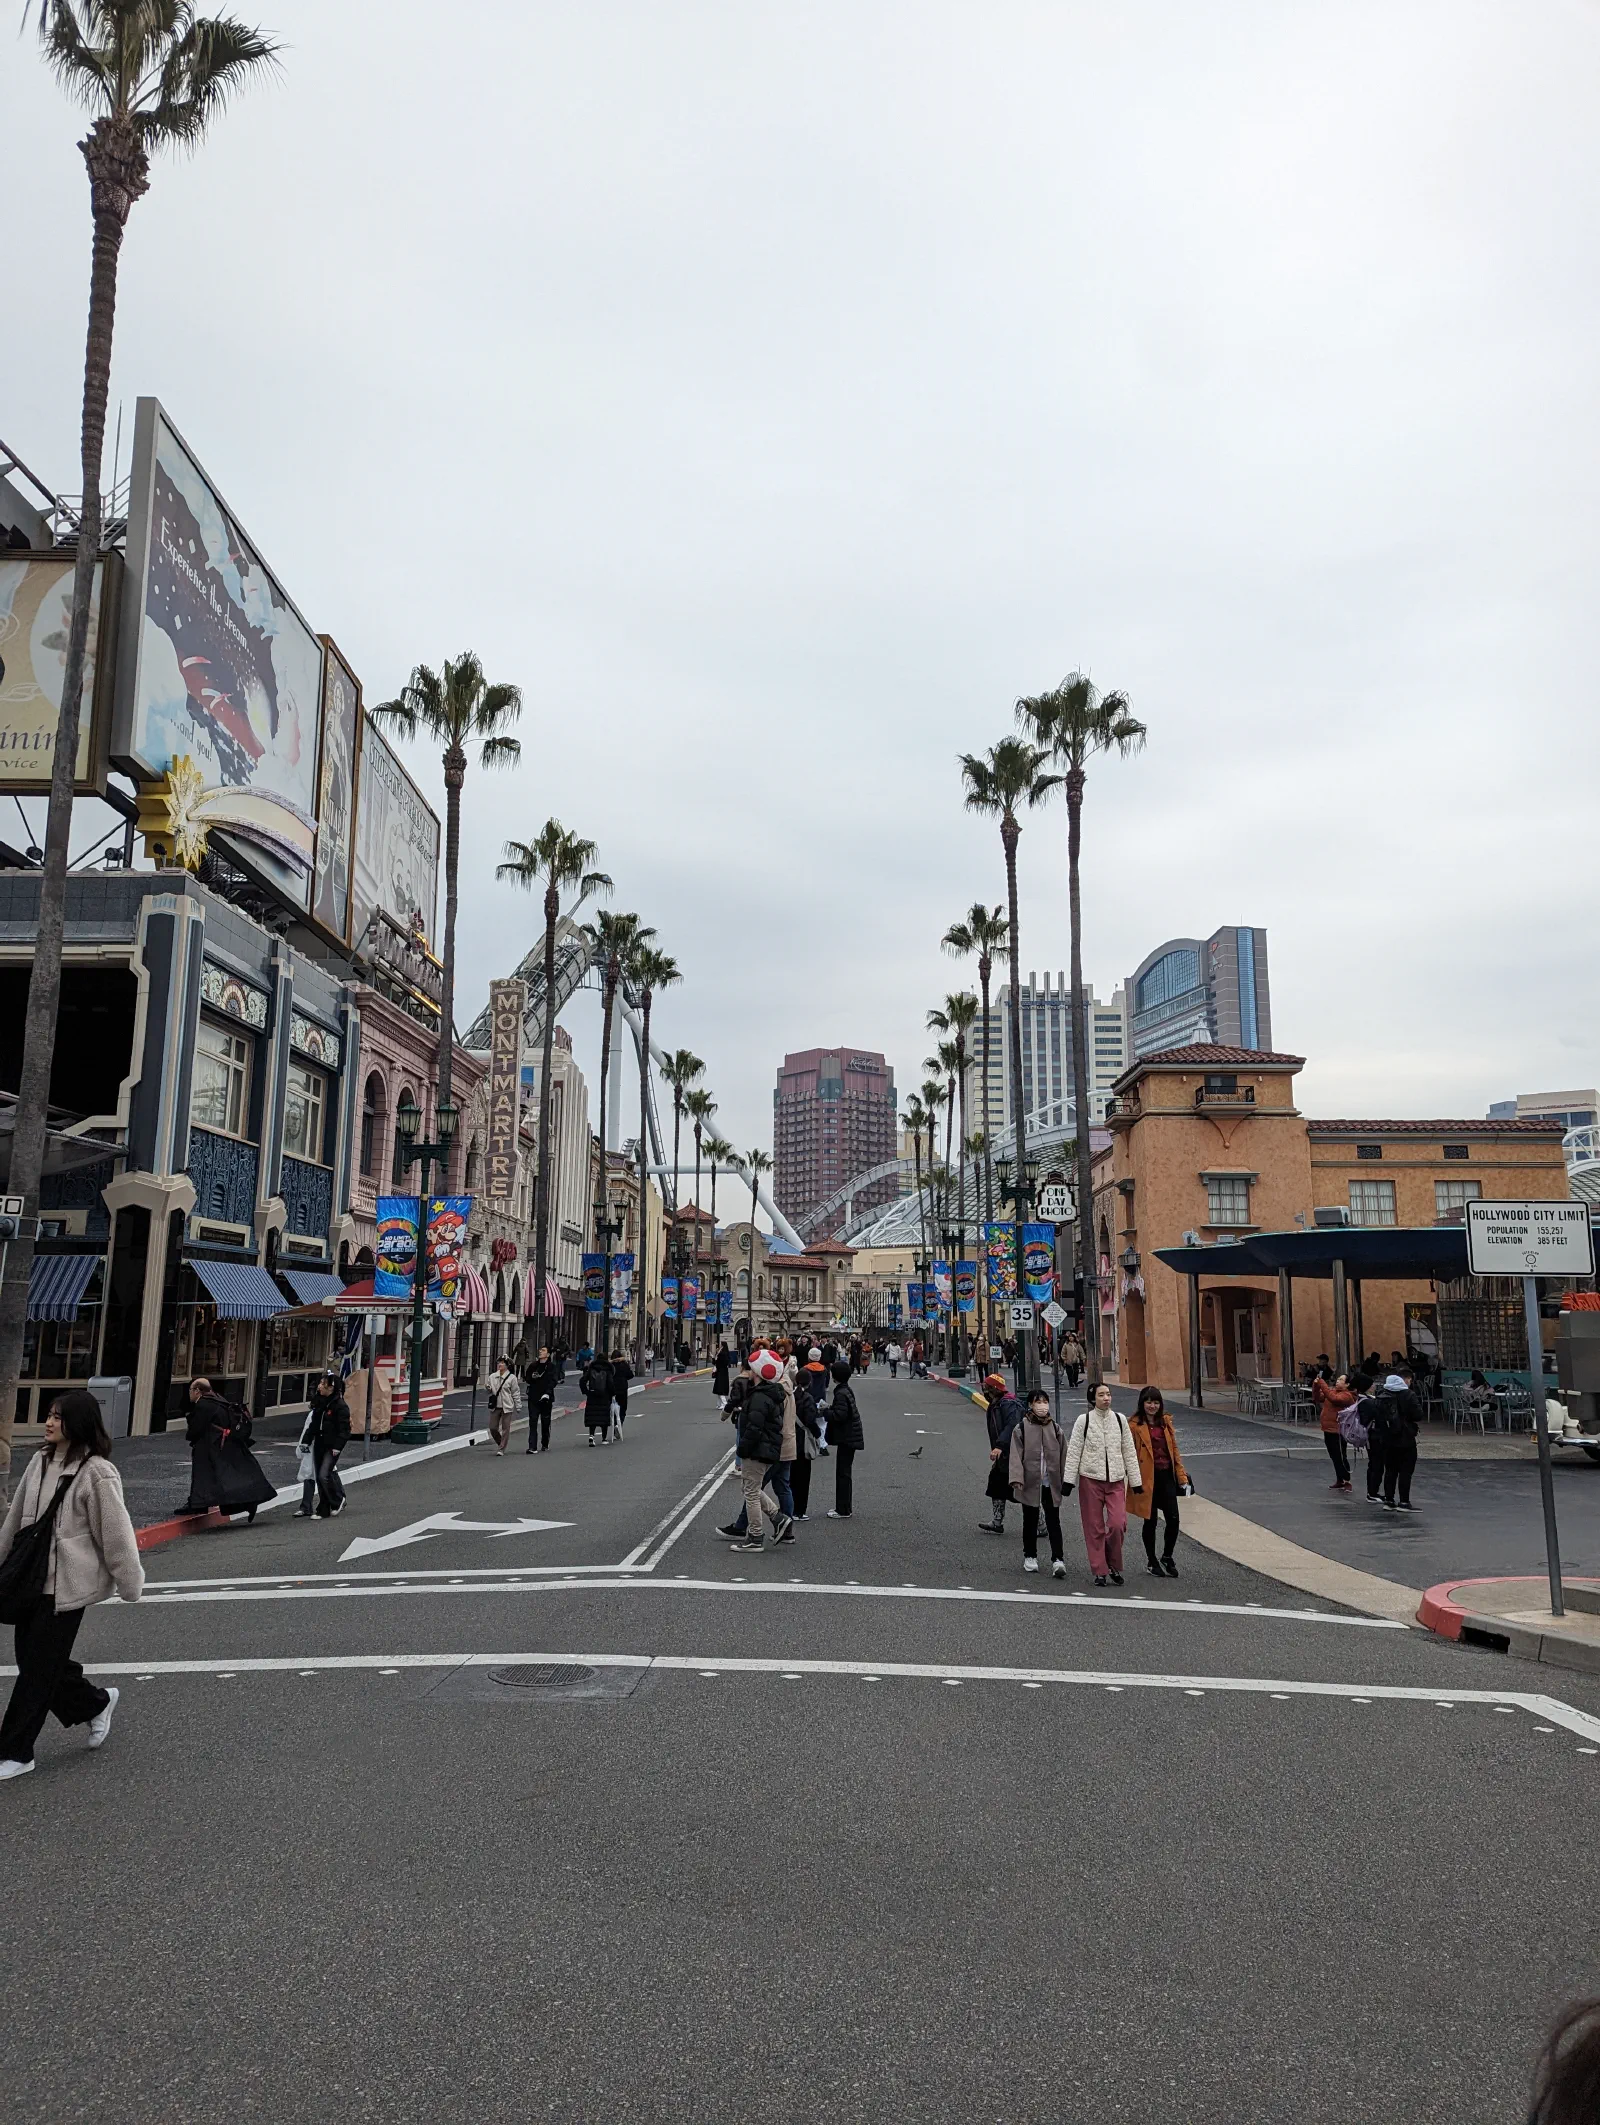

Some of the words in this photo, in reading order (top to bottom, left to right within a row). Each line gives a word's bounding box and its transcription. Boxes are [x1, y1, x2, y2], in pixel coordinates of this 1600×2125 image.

[161, 516, 207, 600] Experience
[210, 584, 222, 616] the
[490, 994, 518, 1196] MONTMARTRE
[1046, 1187, 1066, 1197] ONE
[1047, 1197, 1065, 1206] DAY
[1040, 1207, 1073, 1216] PHOTO
[1472, 1209, 1530, 1221] HOLLYWOOD
[1533, 1210, 1555, 1221] CITY
[1559, 1210, 1586, 1222] LIMIT
[1486, 1226, 1528, 1235] POPULATION
[1537, 1226, 1564, 1236] 155,257
[1487, 1236, 1523, 1245] ELEVATION
[1537, 1237, 1550, 1245] 385
[1552, 1237, 1568, 1245] FEET
[1011, 1307, 1032, 1321] 35
